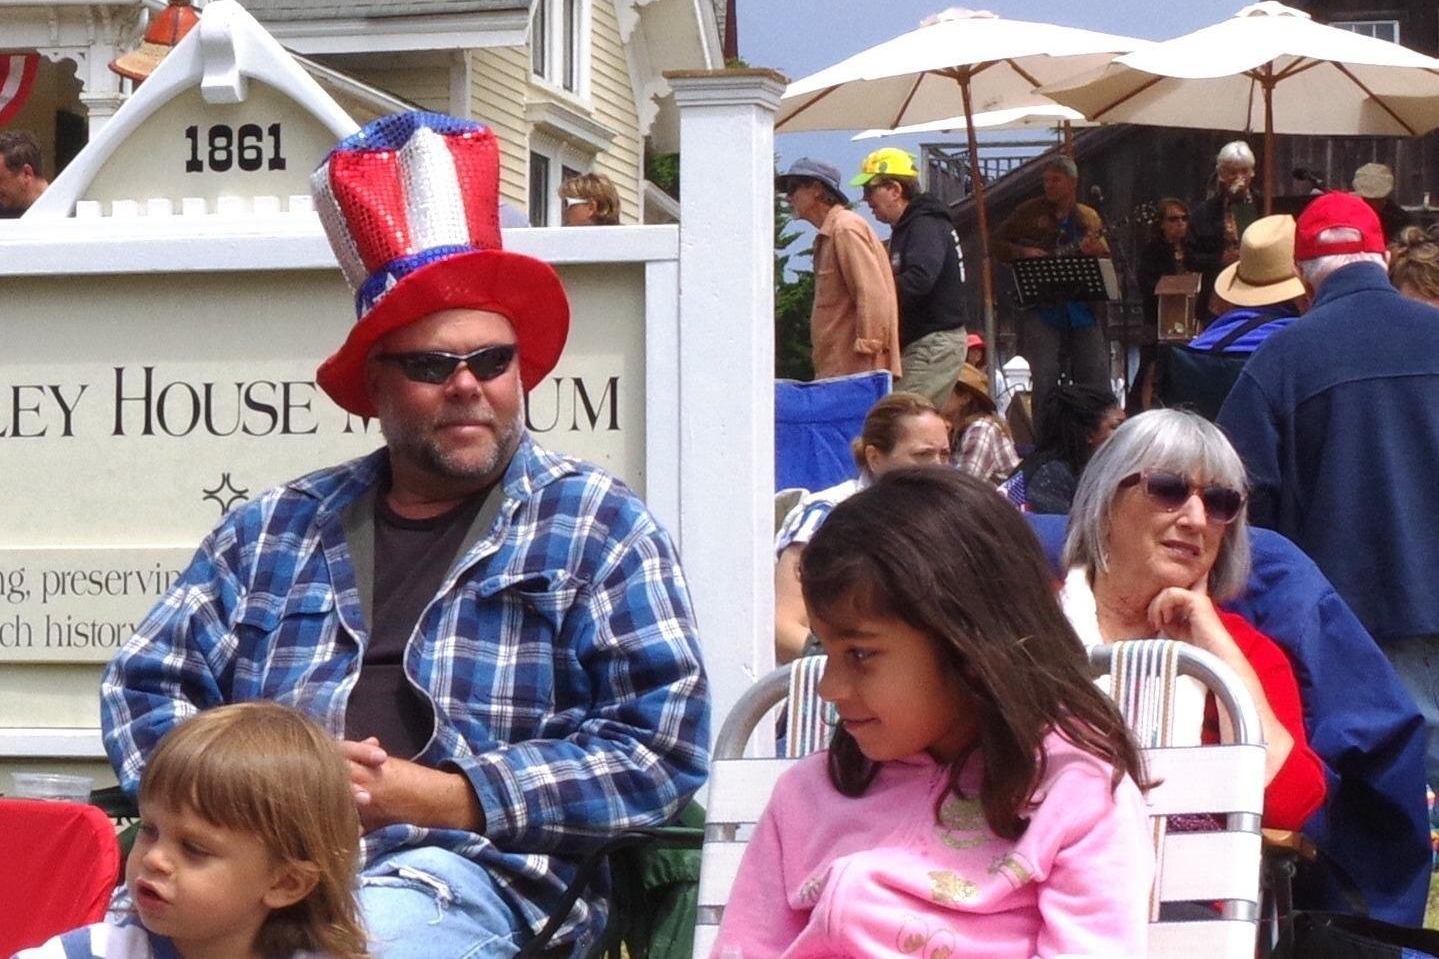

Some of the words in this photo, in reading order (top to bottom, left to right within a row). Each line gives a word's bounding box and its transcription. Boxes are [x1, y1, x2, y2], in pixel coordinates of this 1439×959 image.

[185, 123, 287, 173] 1861
[111, 366, 319, 437] HOUSE
[41, 562, 182, 603] preservin
